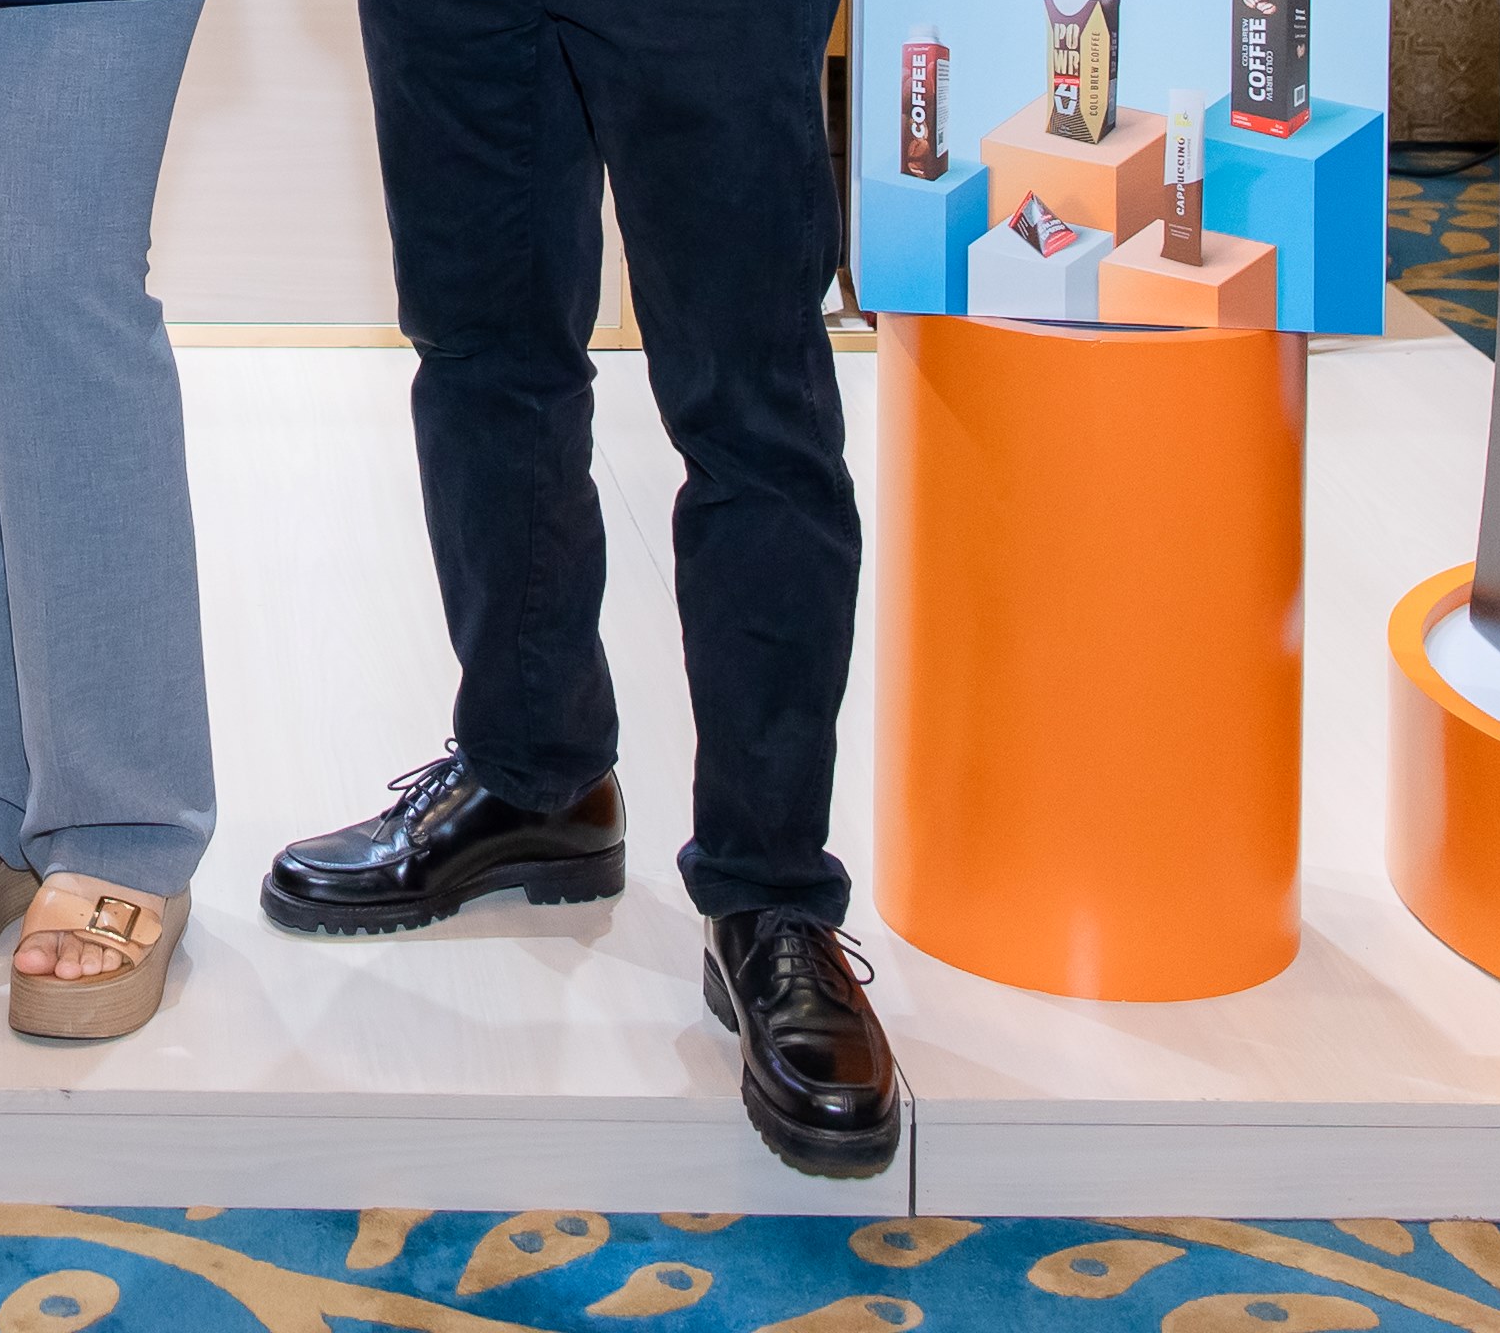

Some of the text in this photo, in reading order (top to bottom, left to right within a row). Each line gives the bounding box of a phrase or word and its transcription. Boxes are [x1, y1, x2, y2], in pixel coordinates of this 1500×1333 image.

[911, 53, 927, 139] COFFEE
[1090, 32, 1100, 116] COLD BREW COFFEE
[1248, 18, 1267, 102] COFFEE
[1175, 137, 1185, 216] CAPPUCCINO
